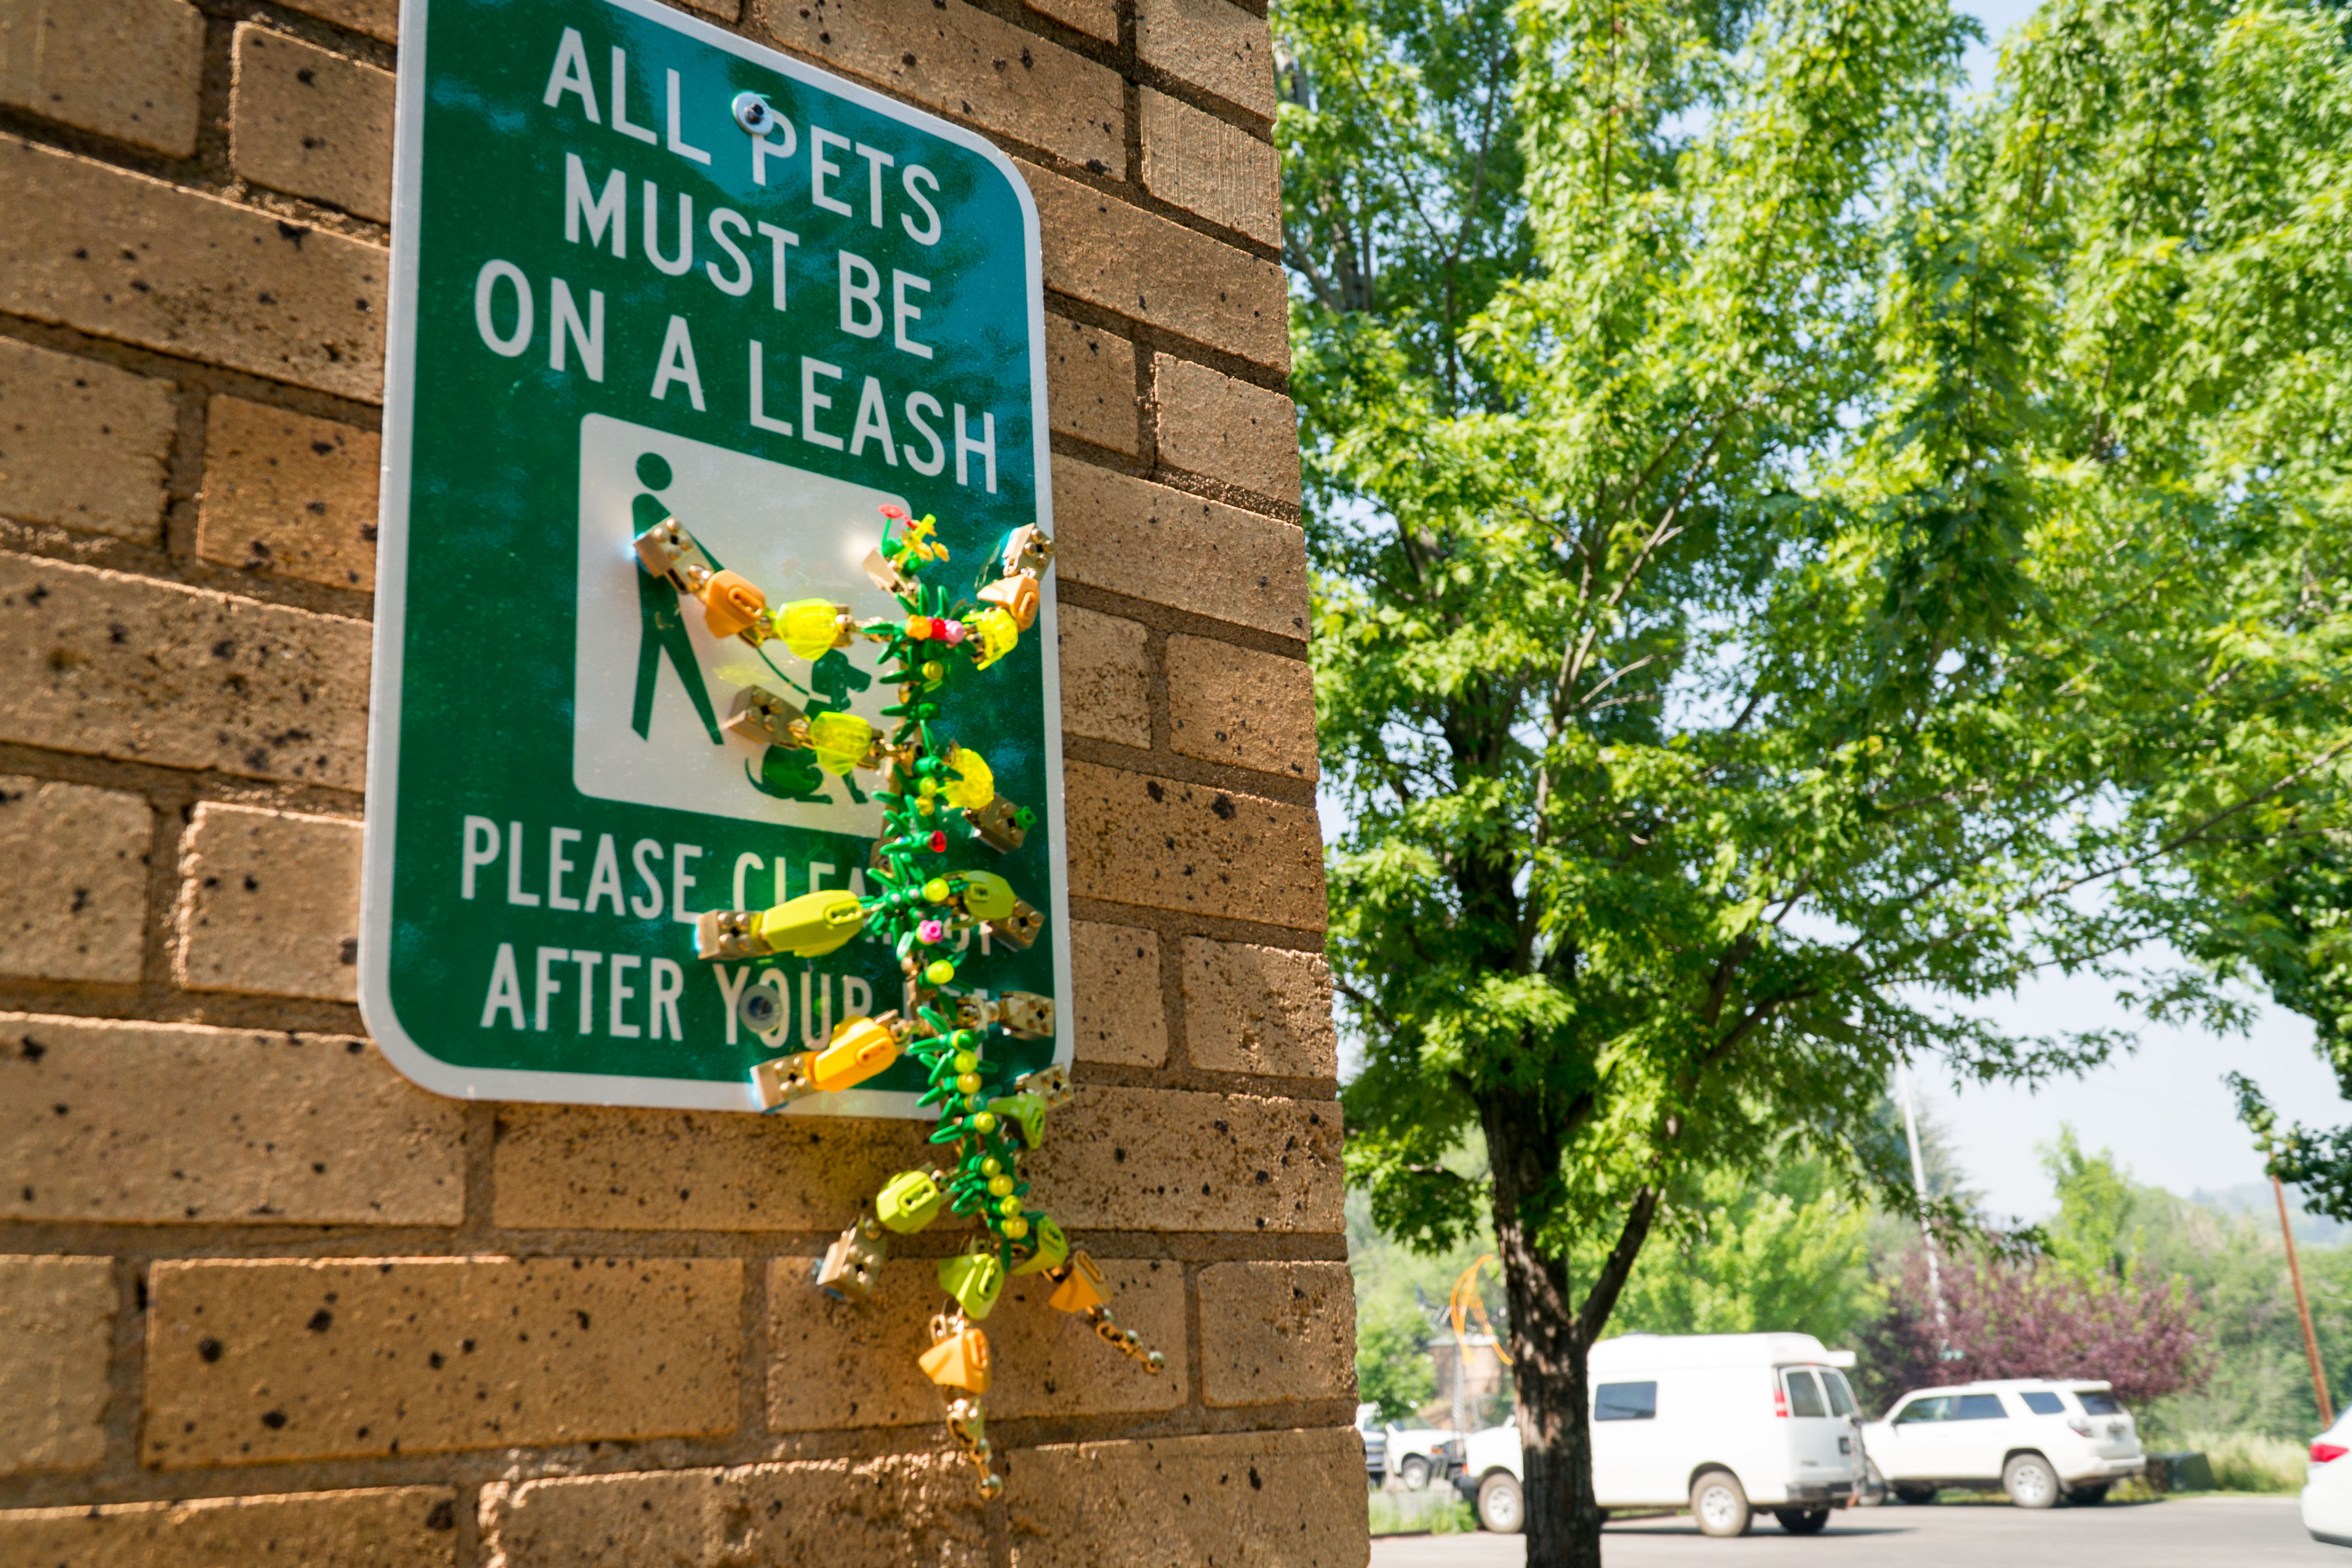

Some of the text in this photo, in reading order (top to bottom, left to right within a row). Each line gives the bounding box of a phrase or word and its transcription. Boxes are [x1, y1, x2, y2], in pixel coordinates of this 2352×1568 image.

[543, 27, 942, 246] ALL PETS
[565, 153, 934, 360] MUST BE
[475, 259, 997, 494] ON A LEASH
[461, 815, 703, 923] PLEASE
[479, 943, 684, 1041] AFTER
